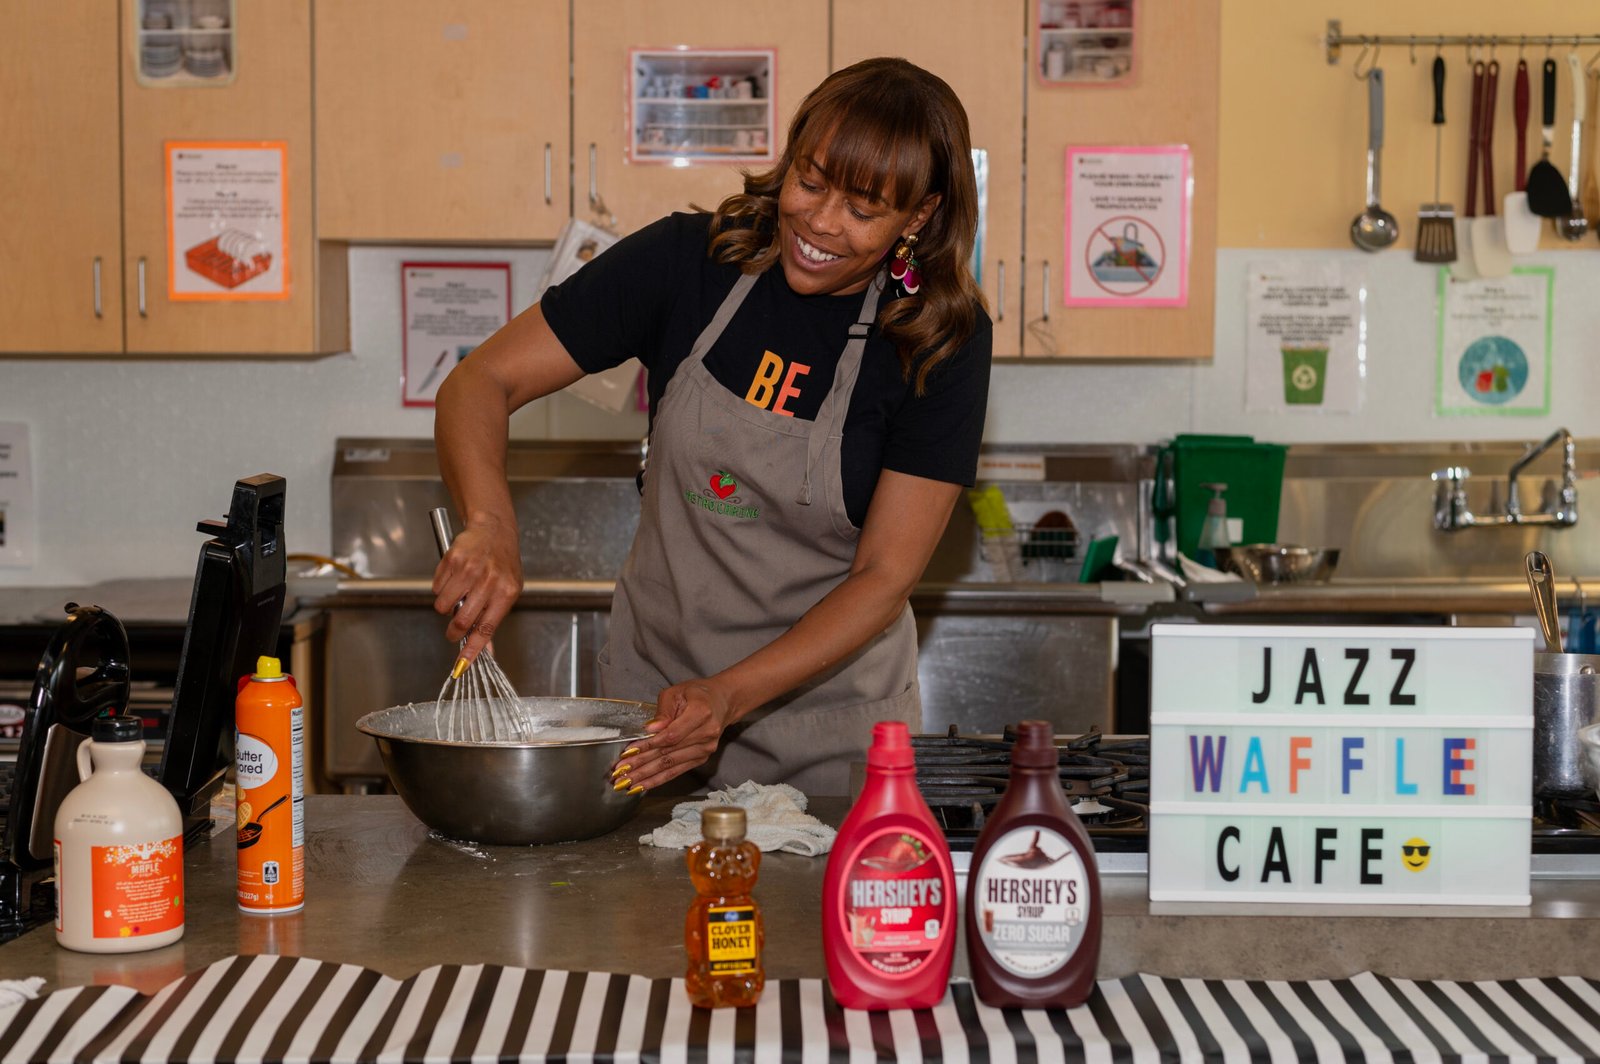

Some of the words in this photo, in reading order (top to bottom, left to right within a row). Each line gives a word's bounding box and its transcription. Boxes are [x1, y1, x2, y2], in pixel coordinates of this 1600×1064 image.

[744, 350, 811, 417] BE
[1252, 647, 1416, 706] JAZZ
[1189, 735, 1476, 795] WAFFLE
[1216, 826, 1384, 884] CAFE
[130, 862, 159, 875] MAPLE
[852, 878, 942, 907] HERSHEY'S
[987, 878, 1077, 905] HERSHEY'S
[881, 907, 913, 924] SYRUP
[1017, 906, 1045, 918] SYRUP
[711, 924, 751, 935] CLOVER
[993, 924, 1026, 942] ZERO
[1028, 925, 1070, 943] SUGAR
[712, 936, 751, 950] HONEY
